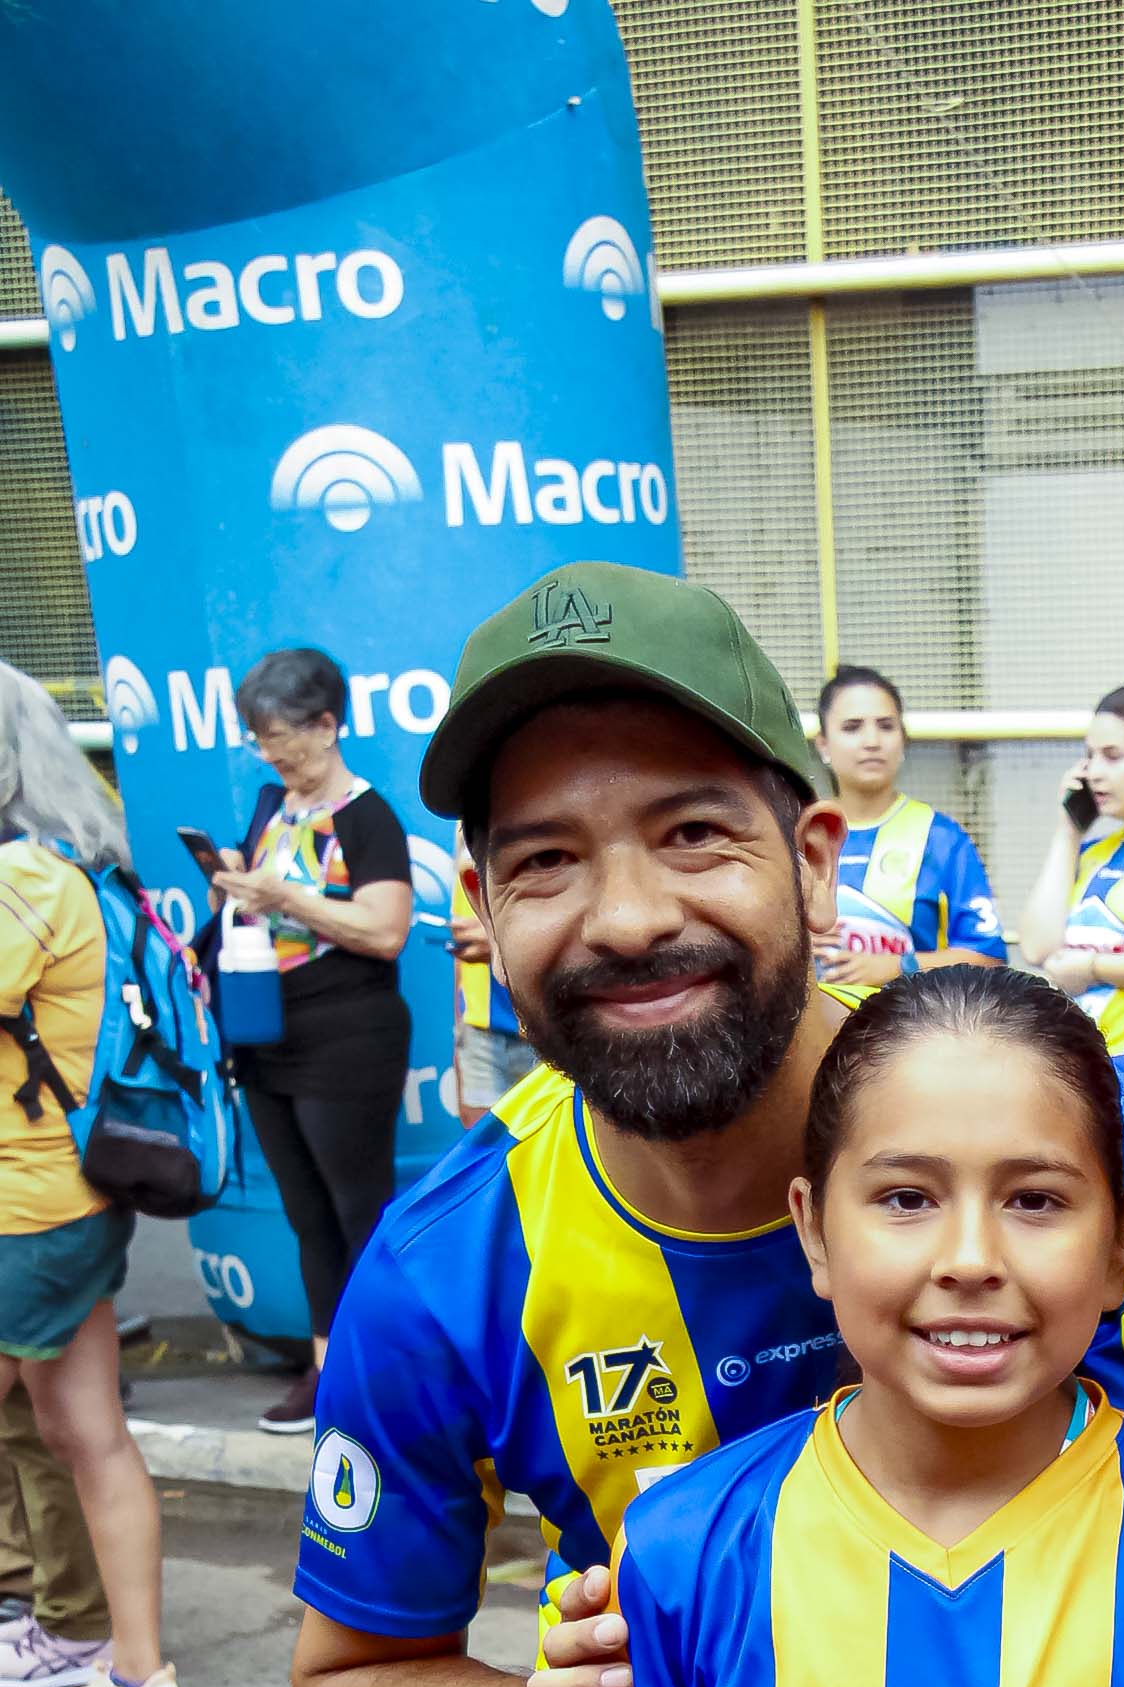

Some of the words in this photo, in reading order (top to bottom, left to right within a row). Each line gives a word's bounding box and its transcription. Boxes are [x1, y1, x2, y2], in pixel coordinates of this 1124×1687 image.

[106, 246, 404, 341] Macro
[443, 440, 668, 527] Macro
[527, 580, 612, 646] LA
[168, 666, 451, 752] Mro
[564, 1334, 672, 1419] 17
[588, 1407, 681, 1435] MARATÓN
[594, 1422, 682, 1447] CANALLA
